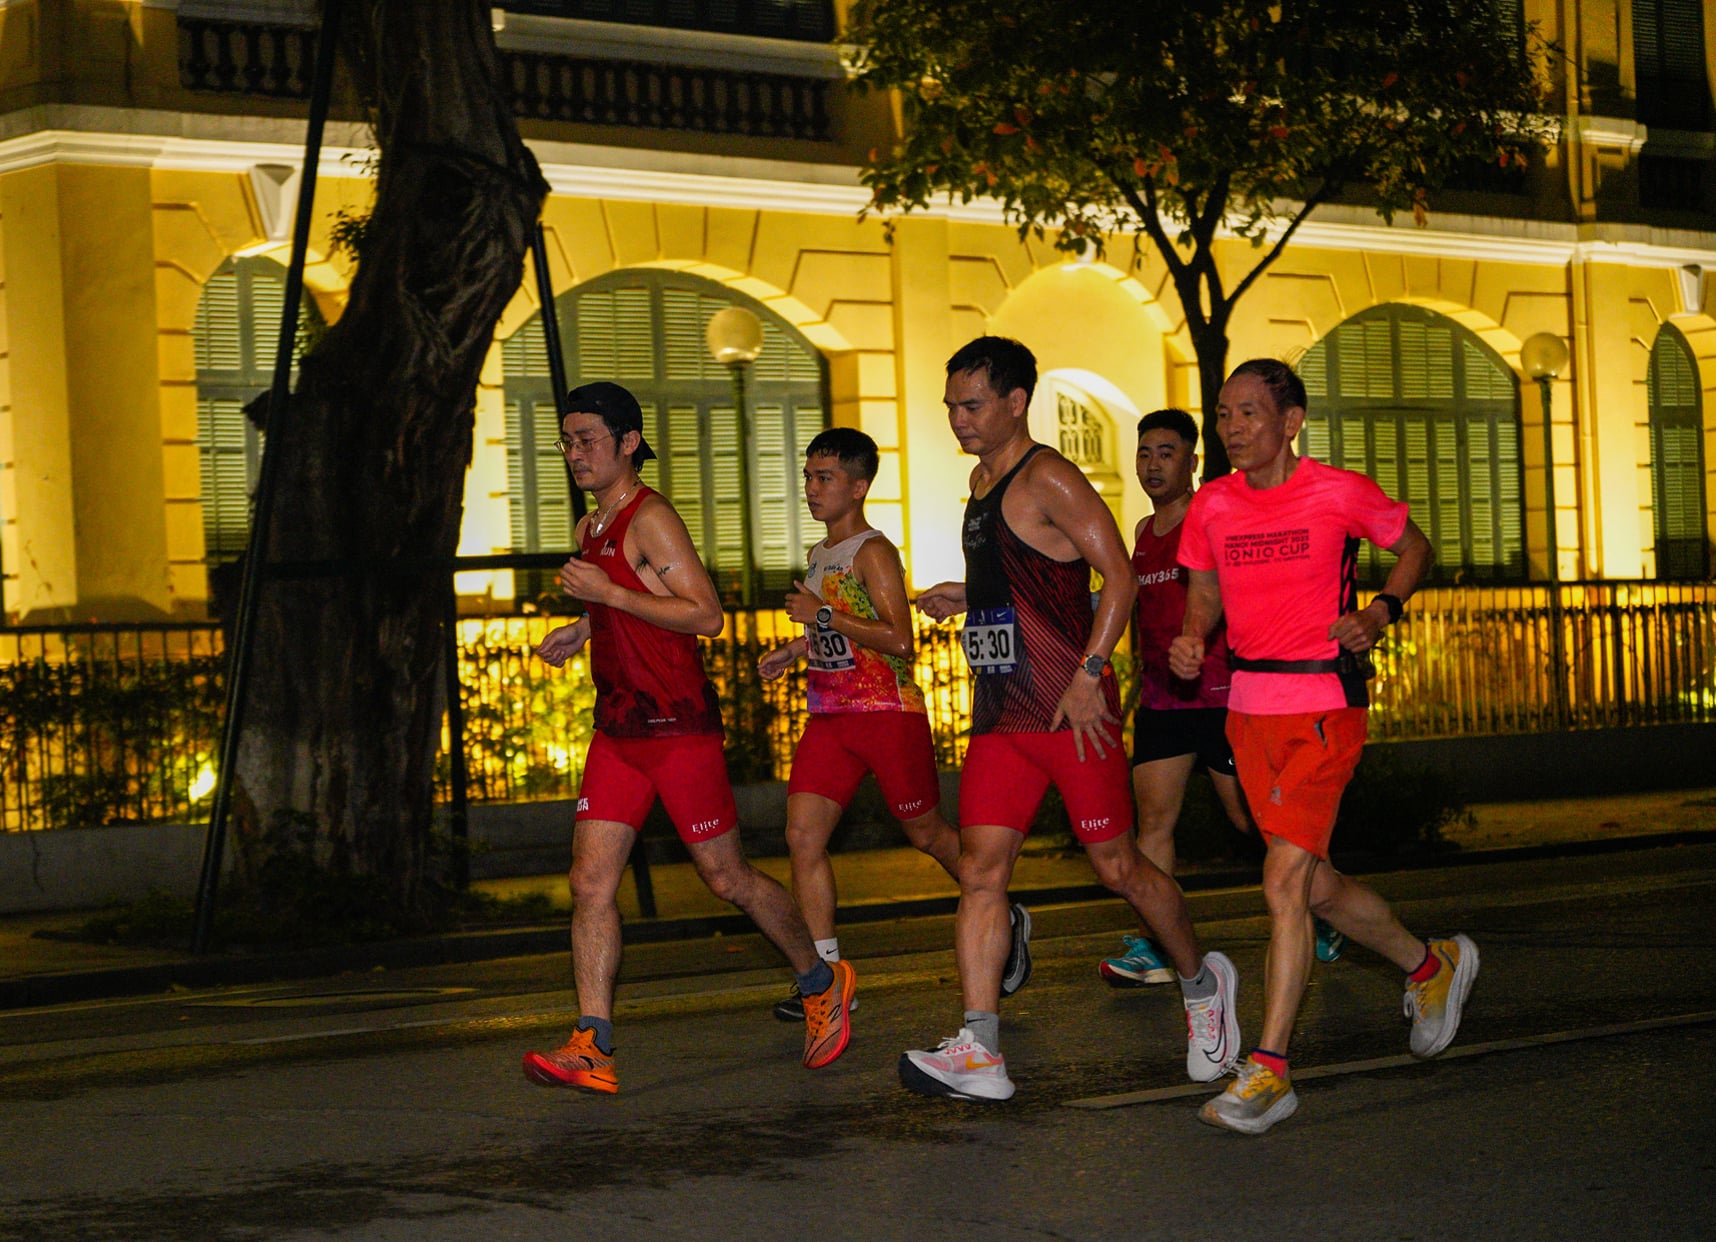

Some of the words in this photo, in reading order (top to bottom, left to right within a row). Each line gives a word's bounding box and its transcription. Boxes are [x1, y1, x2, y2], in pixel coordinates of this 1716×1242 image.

[1266, 528, 1309, 538] MARATHON
[1250, 537, 1289, 547] MIDNIGHT
[1279, 542, 1310, 556] CUP
[968, 629, 1010, 660] 5:30
[898, 799, 923, 812] Elite
[691, 817, 720, 833] Elite
[1080, 816, 1110, 831] Elite
